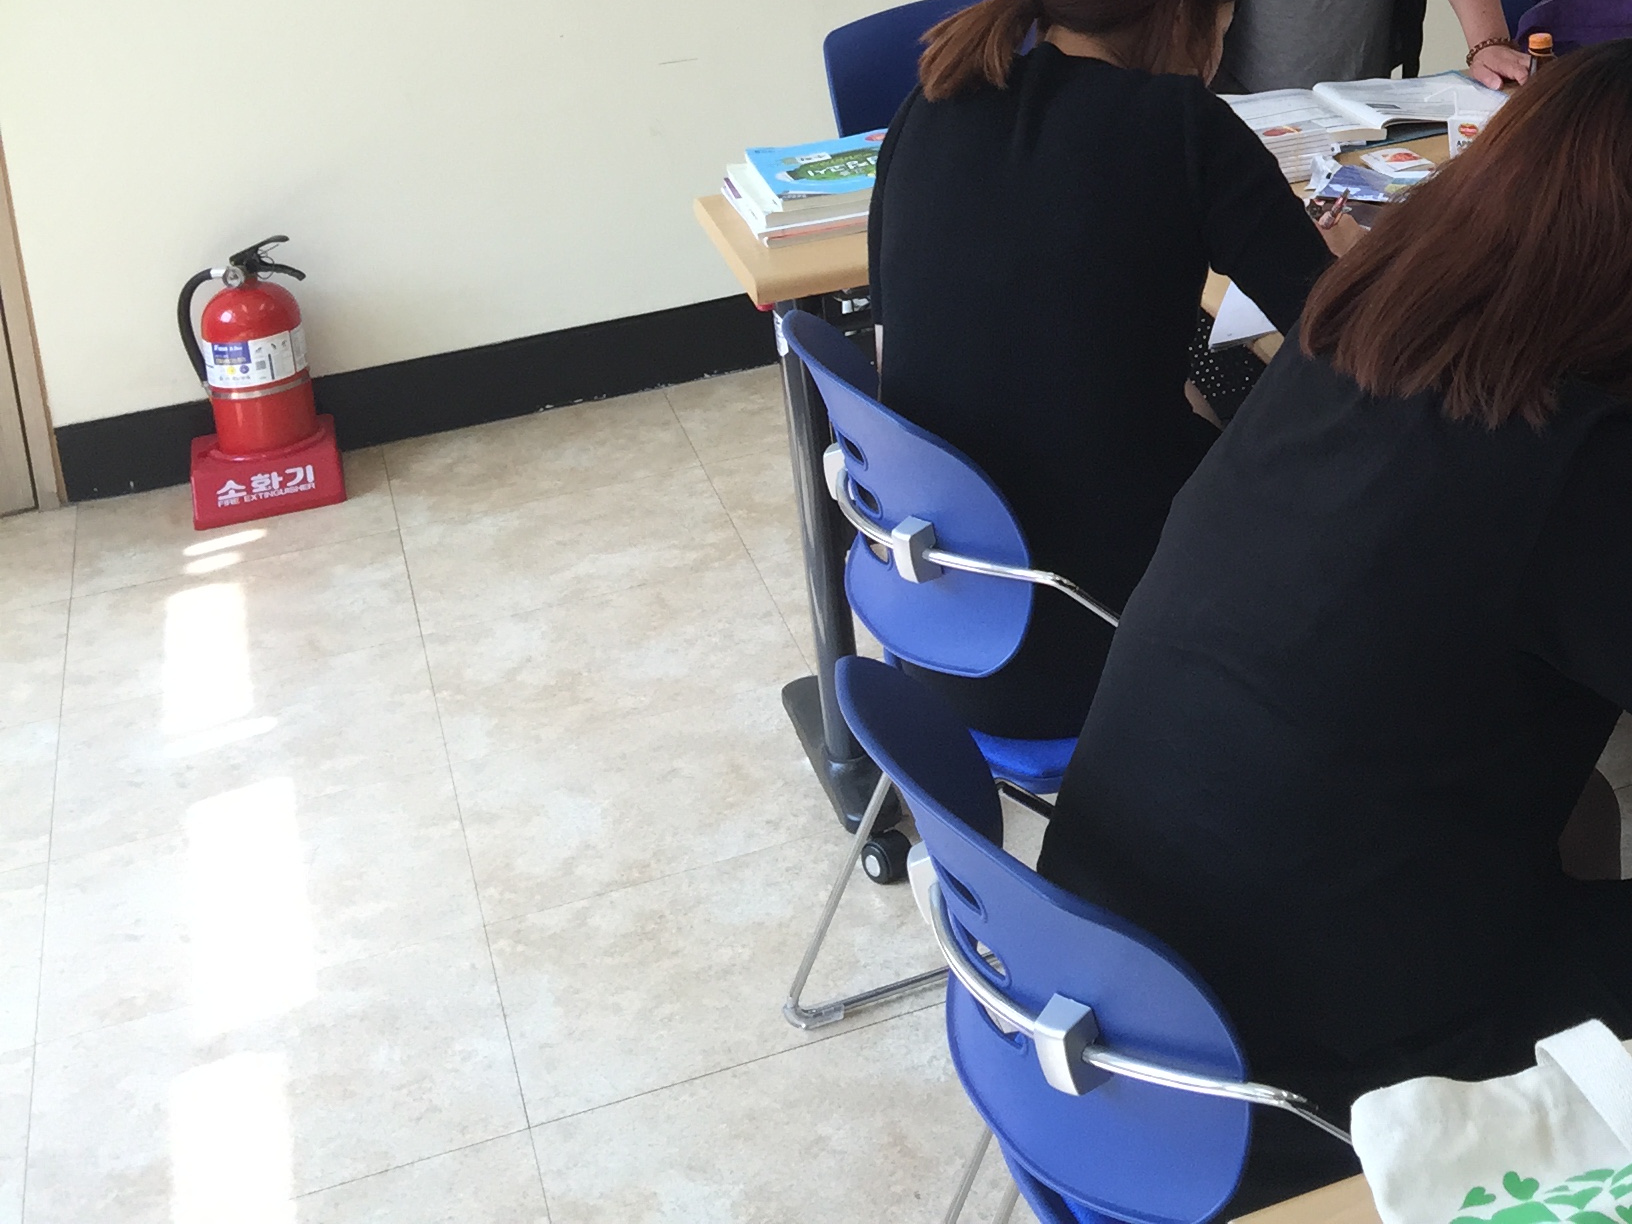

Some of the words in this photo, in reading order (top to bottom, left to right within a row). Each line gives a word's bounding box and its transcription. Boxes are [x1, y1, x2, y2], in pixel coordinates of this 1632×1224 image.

[216, 464, 315, 501] 소화기
[217, 497, 240, 508] FIRE
[244, 482, 316, 503] EXTINGUISHER
